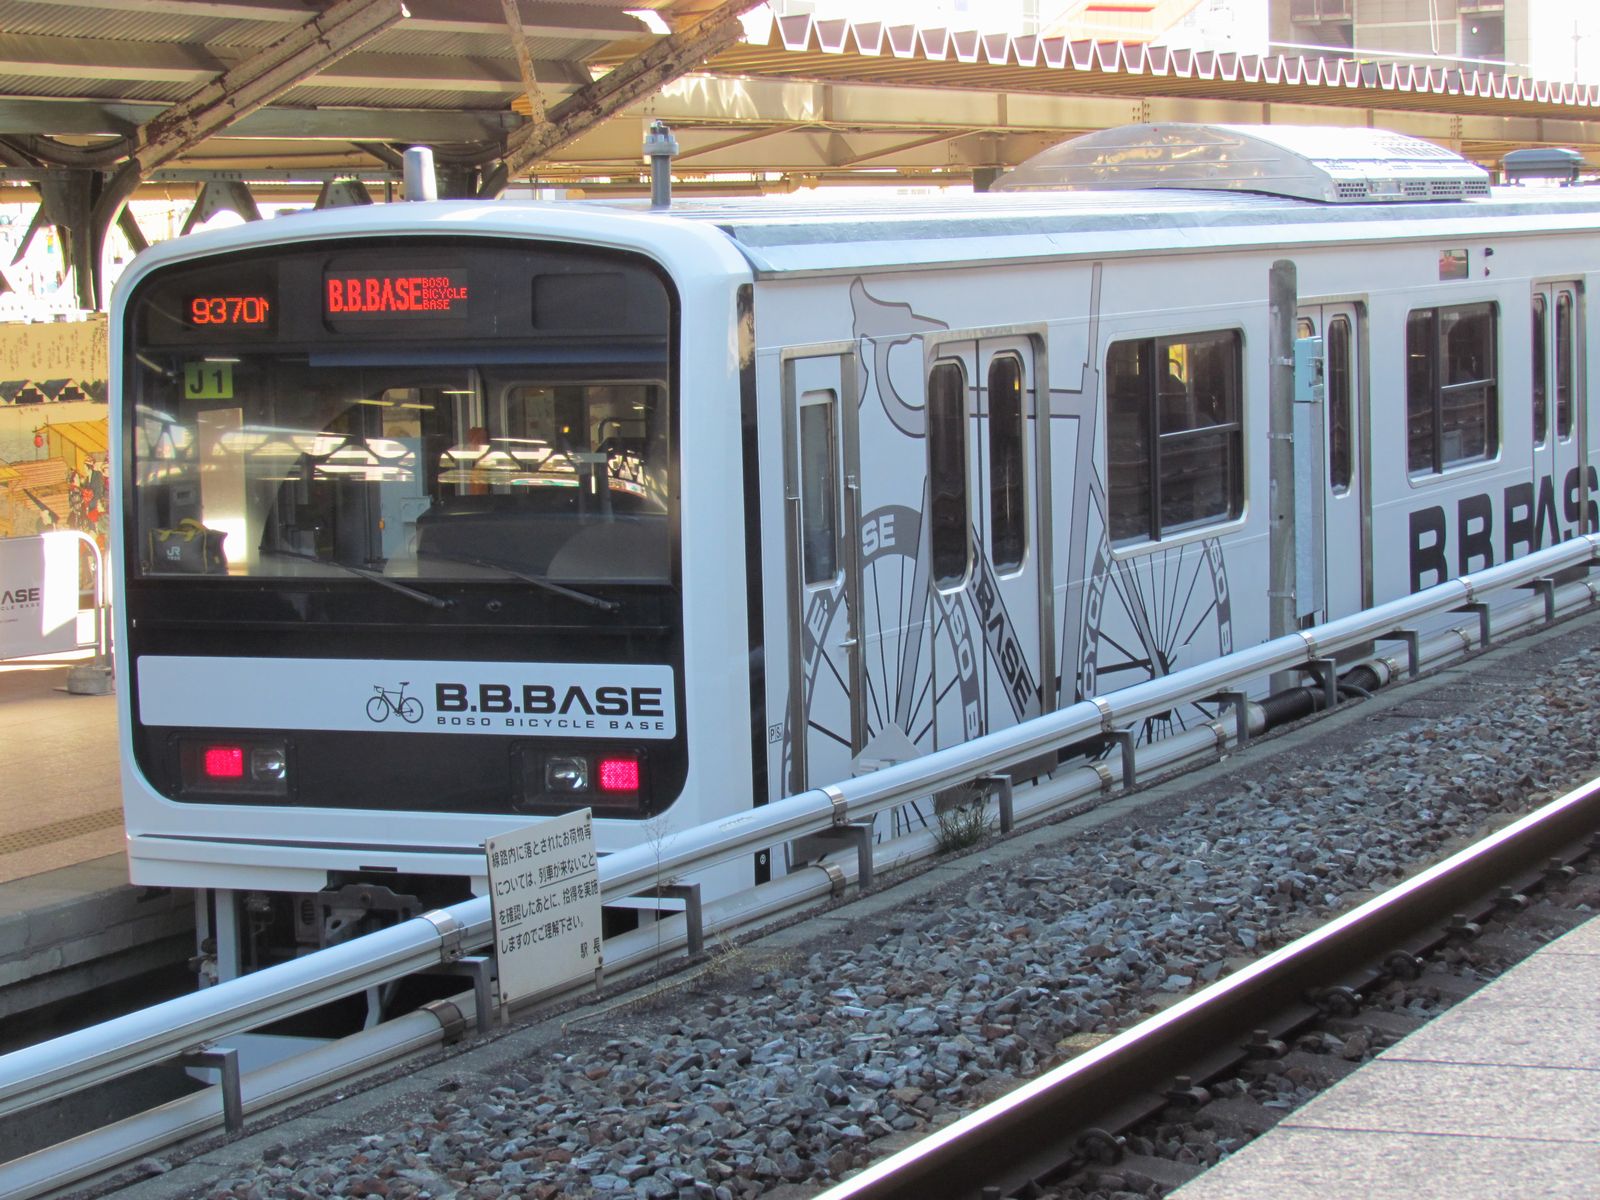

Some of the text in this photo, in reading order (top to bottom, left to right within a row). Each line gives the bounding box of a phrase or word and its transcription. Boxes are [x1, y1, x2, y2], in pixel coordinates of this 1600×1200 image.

[328, 277, 422, 313] B.B.BASE
[422, 277, 449, 288] BOSO
[422, 287, 468, 300] BICYCLE
[422, 299, 450, 310] BASE
[166, 546, 181, 556] JR
[435, 682, 664, 717] B.B.BASE
[437, 716, 665, 731] BOSO BICYCLE BASE
[491, 823, 592, 868] 線路内に落とされたお荷物等
[495, 853, 596, 897] については、列車が来ないこと
[498, 879, 599, 926] を確認したあとに、拾得を実施
[501, 914, 584, 954] しますのでご理解下さい。
